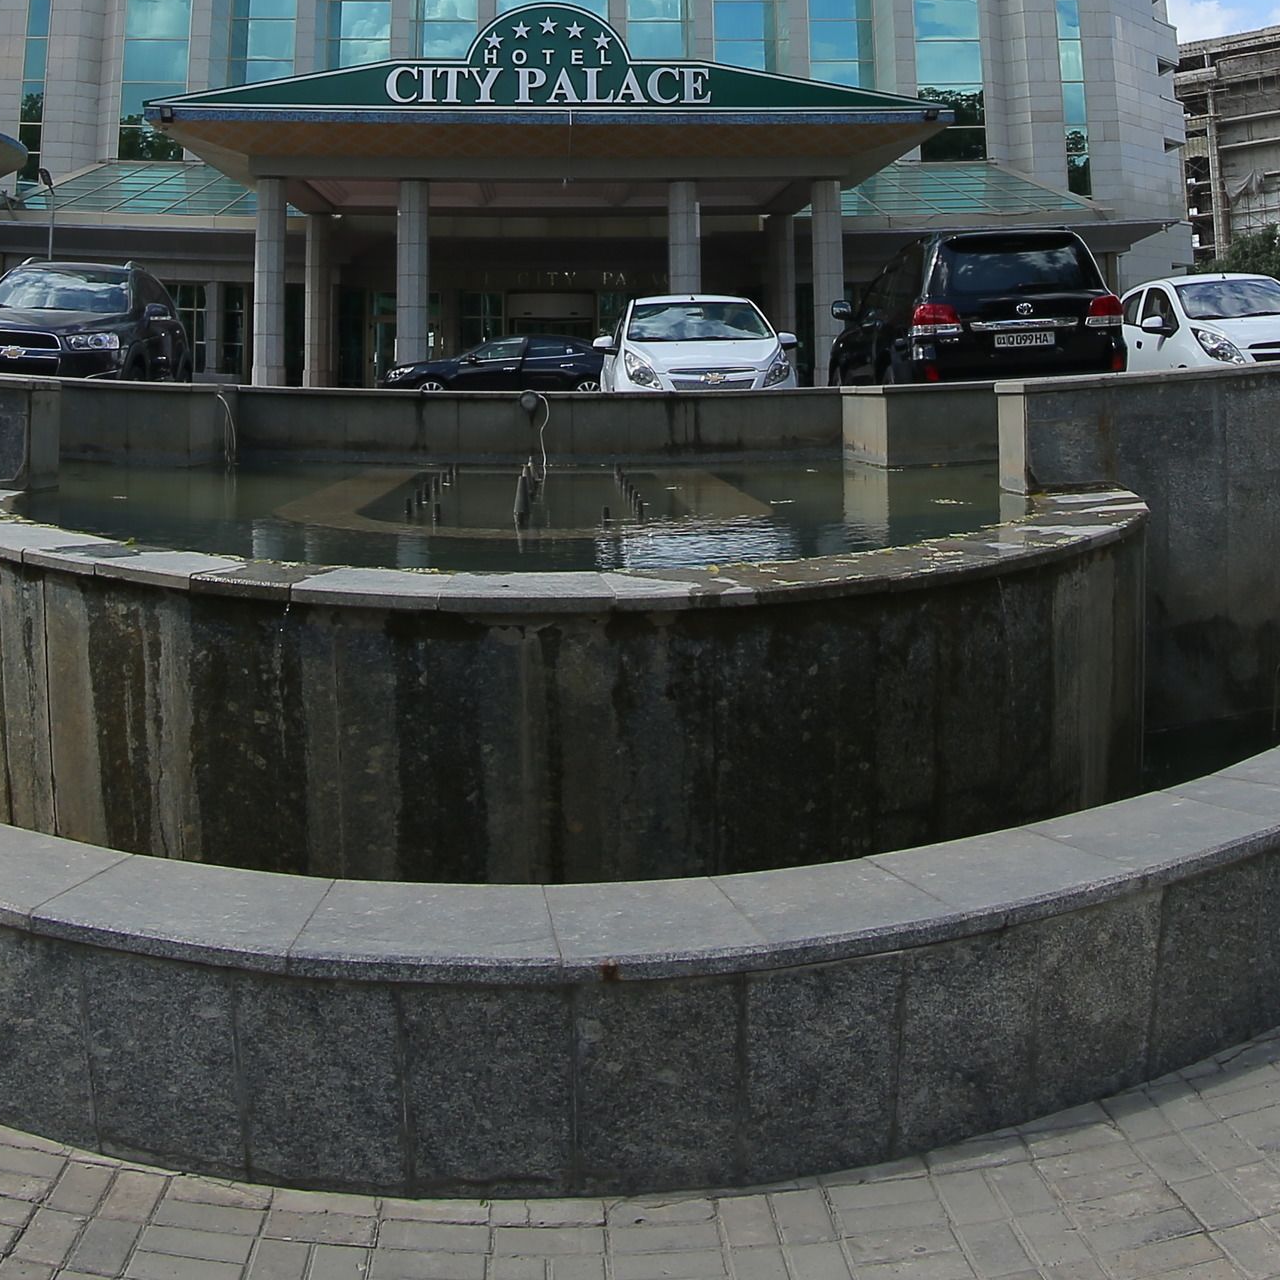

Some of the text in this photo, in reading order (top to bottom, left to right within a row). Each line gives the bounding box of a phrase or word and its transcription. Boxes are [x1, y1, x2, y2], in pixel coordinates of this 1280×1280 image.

[484, 49, 612, 65] HOTEL
[385, 66, 712, 104] CITY PALACE
